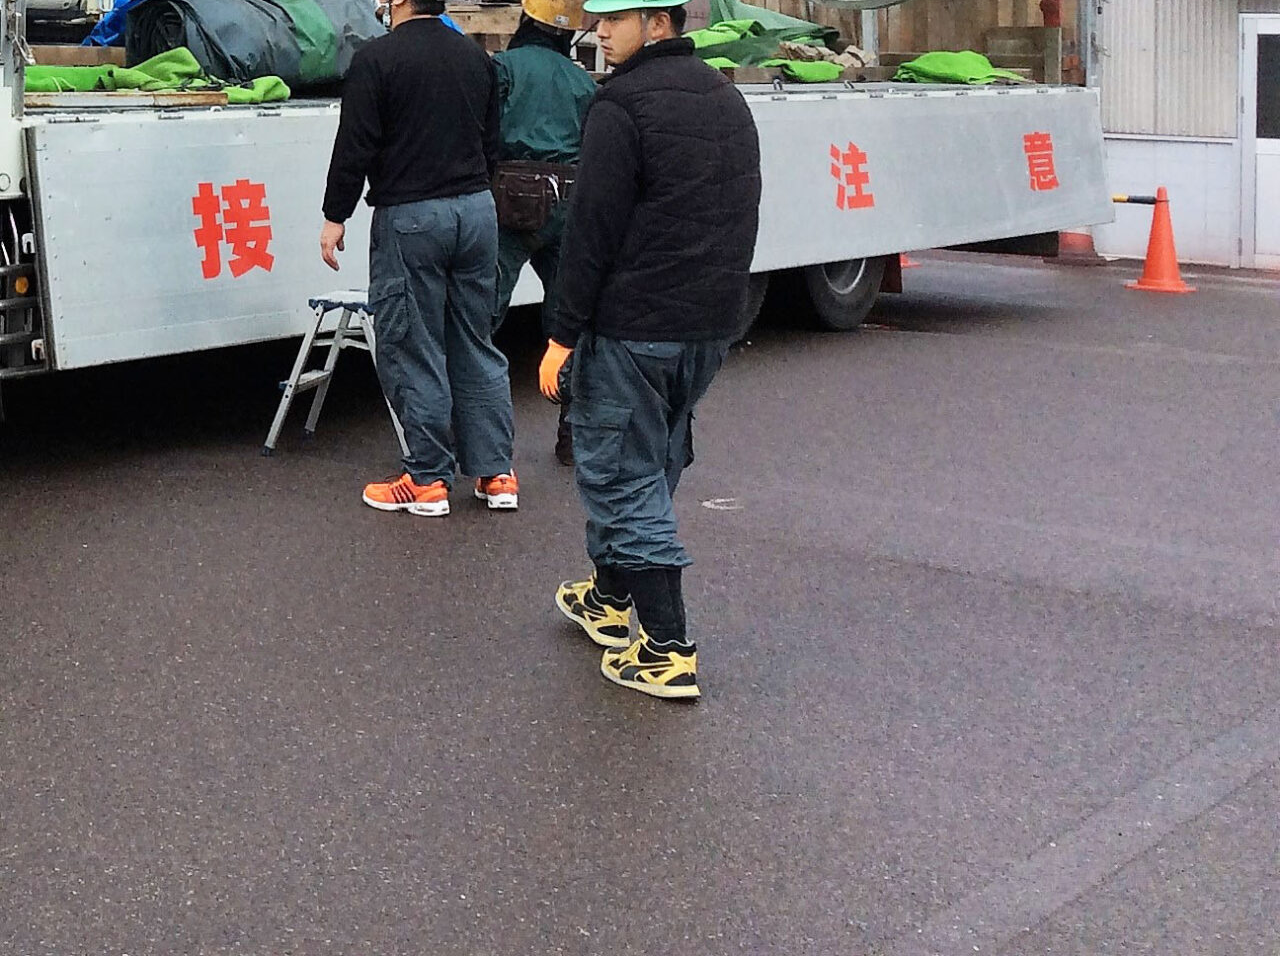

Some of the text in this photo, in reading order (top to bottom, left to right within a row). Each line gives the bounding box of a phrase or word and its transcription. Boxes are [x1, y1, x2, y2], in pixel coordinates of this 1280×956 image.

[192, 132, 1060, 280] 接 注 意
